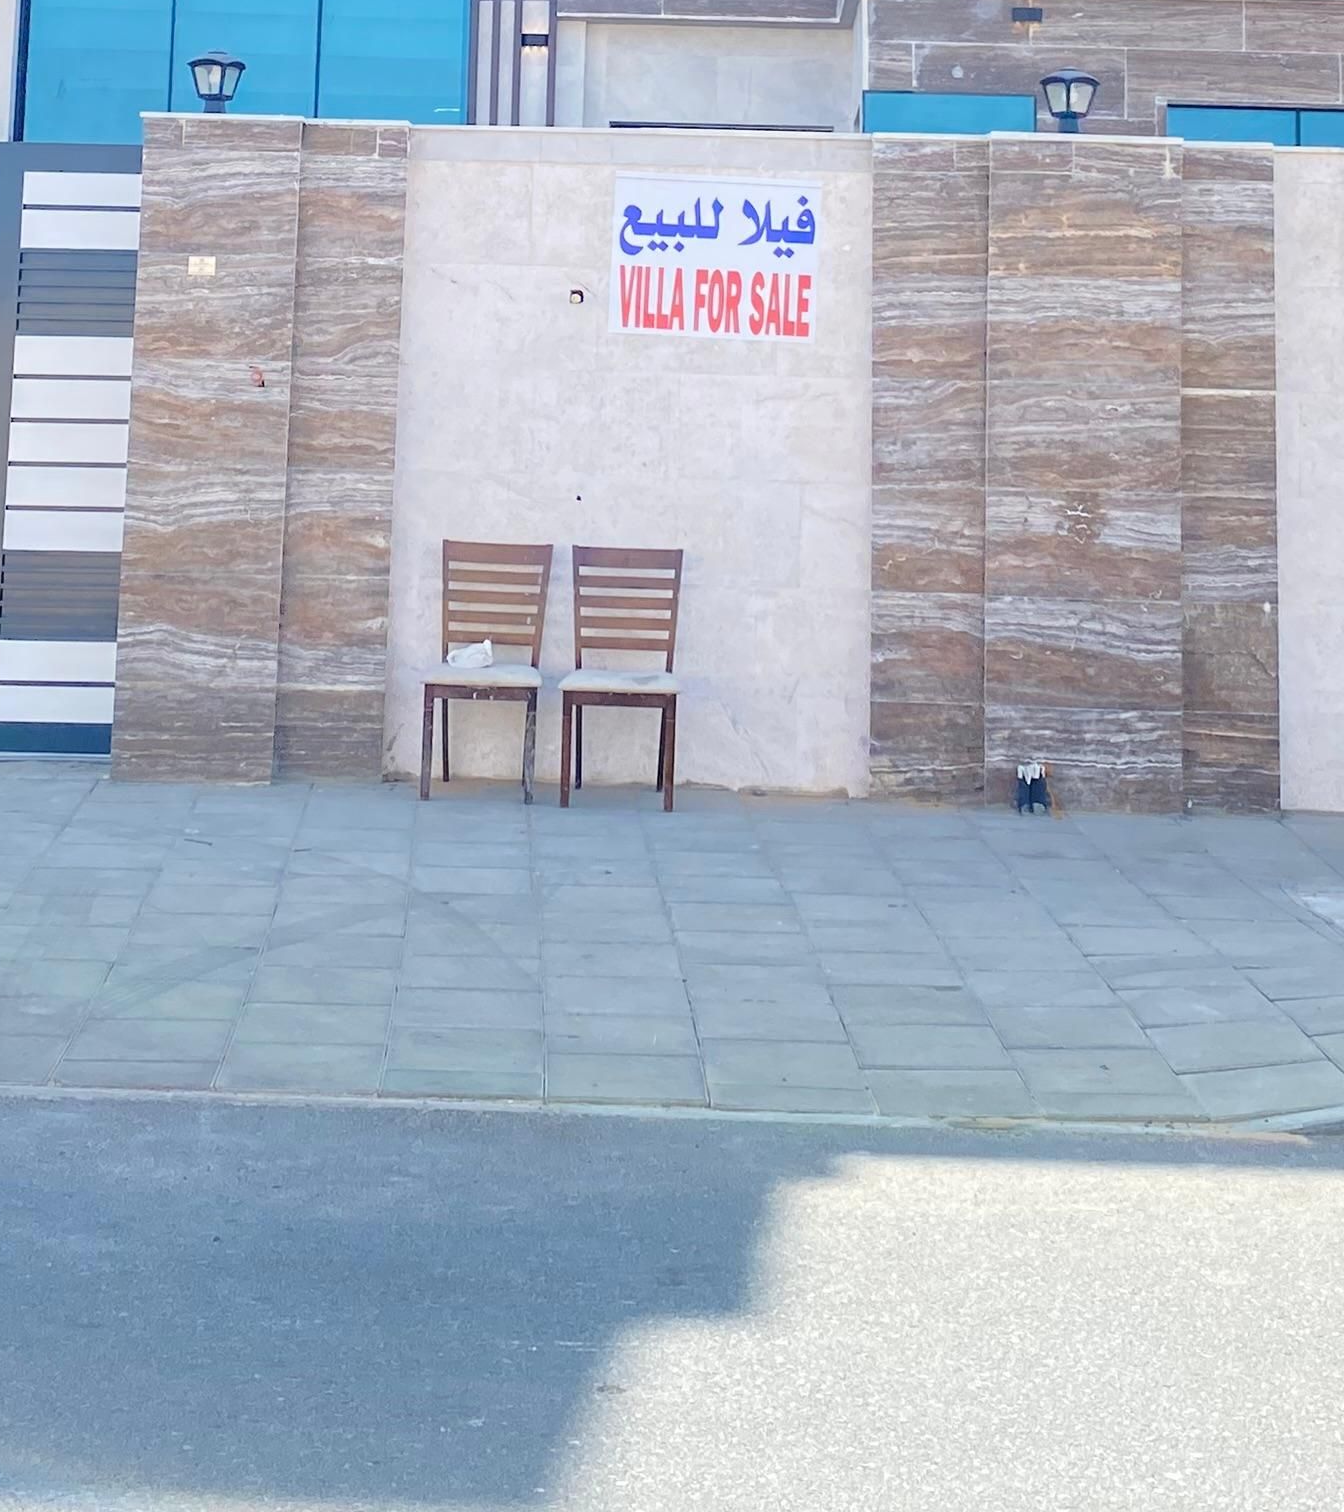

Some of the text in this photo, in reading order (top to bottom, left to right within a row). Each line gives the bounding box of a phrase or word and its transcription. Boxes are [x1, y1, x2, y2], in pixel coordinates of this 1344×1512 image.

[619, 195, 816, 258] فيلا للبيع
[619, 264, 812, 337] VILLA FOR SALE
